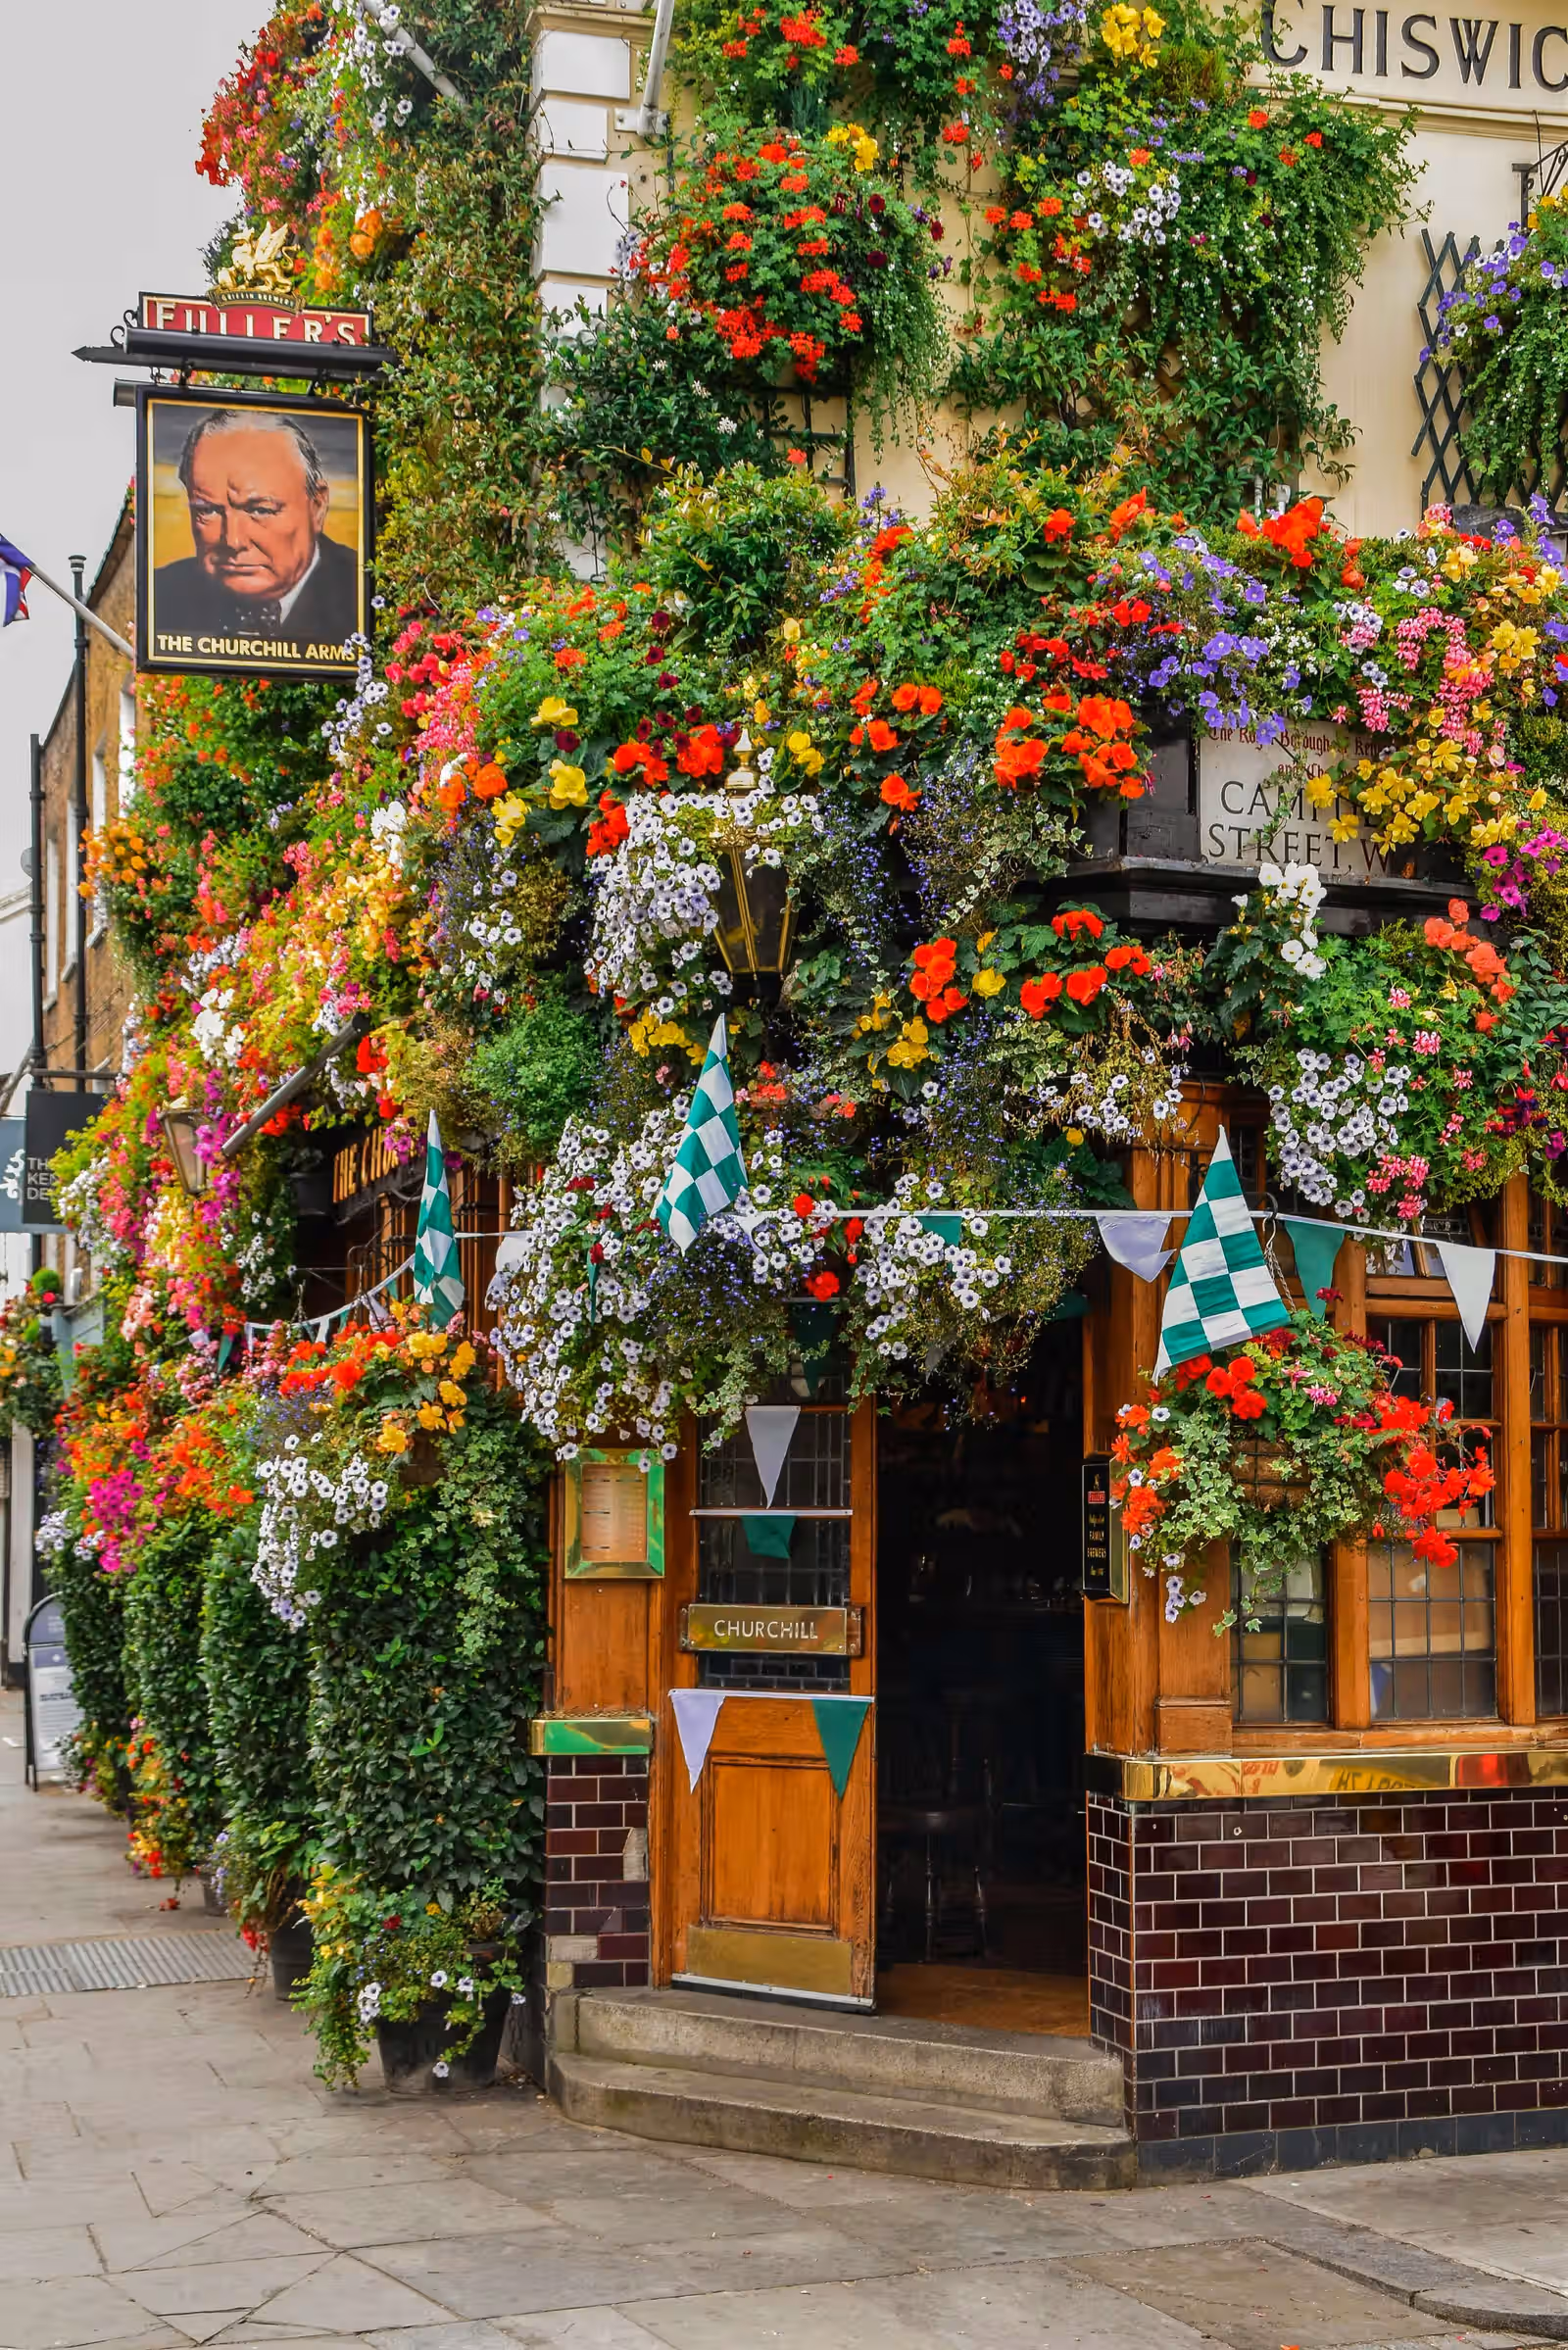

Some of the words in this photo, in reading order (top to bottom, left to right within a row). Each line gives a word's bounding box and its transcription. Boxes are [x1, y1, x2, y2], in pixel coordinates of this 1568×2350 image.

[157, 634, 193, 653] THE
[197, 636, 302, 659] CHURCHILL
[714, 1619, 819, 1640] CHURCHILL
